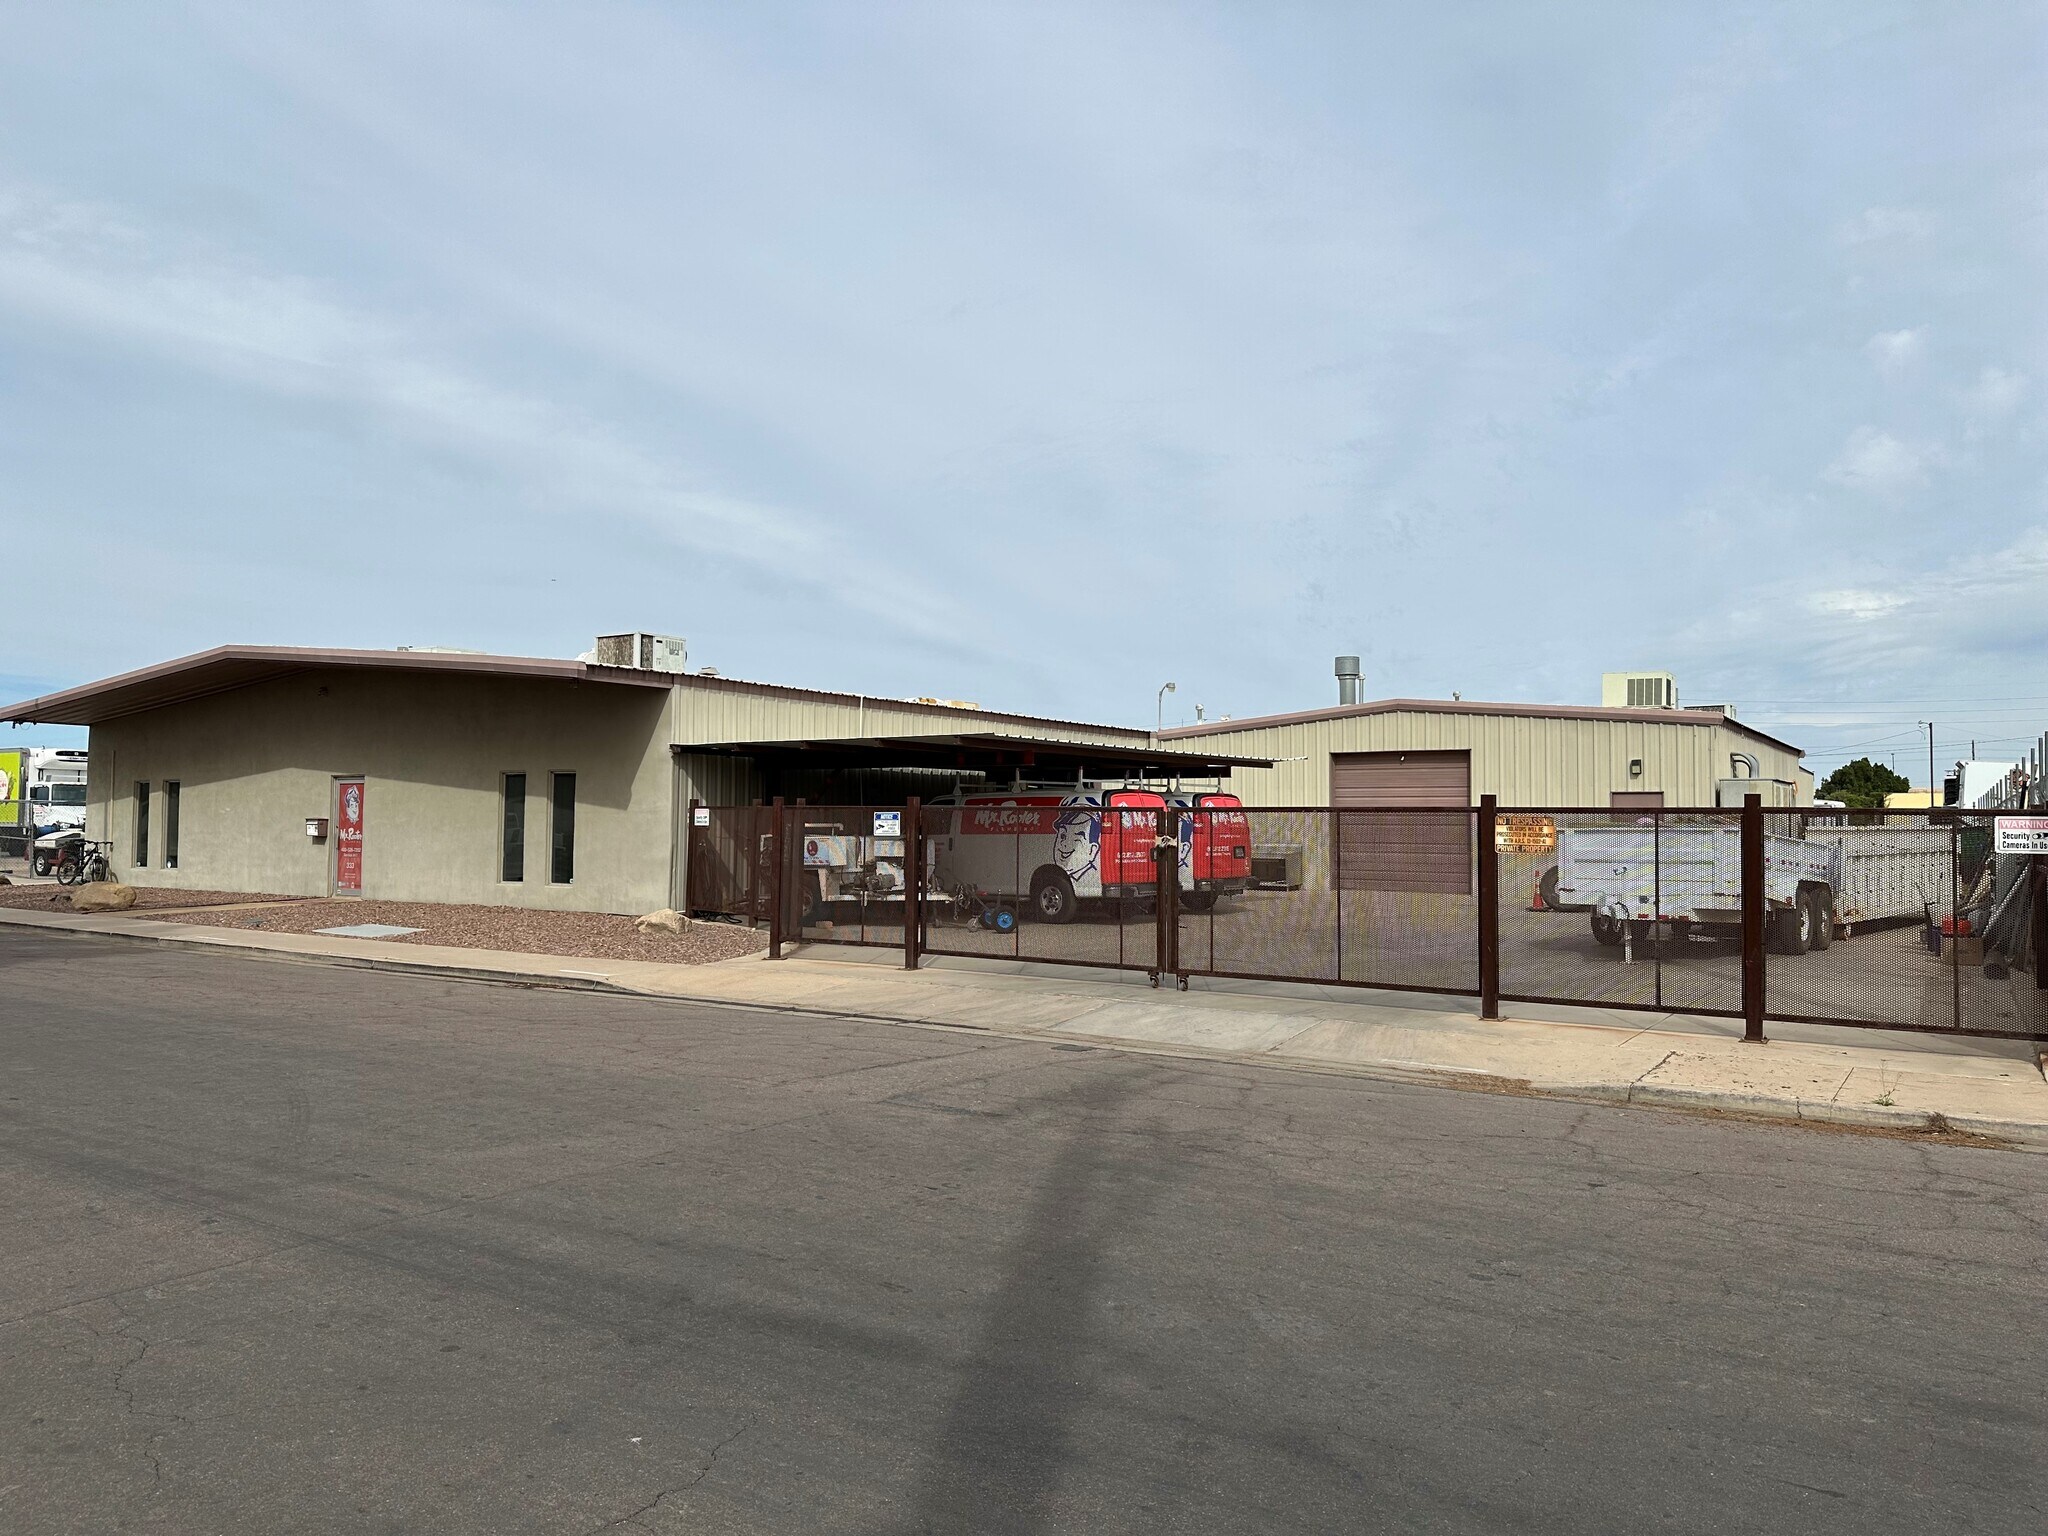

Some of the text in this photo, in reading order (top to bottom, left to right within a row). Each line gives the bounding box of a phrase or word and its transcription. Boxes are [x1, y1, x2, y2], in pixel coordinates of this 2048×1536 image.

[1497, 817, 1553, 825] NO TRESPASSING
[2002, 831, 2030, 841] Security
[2002, 841, 2048, 849] Cameras In Us
